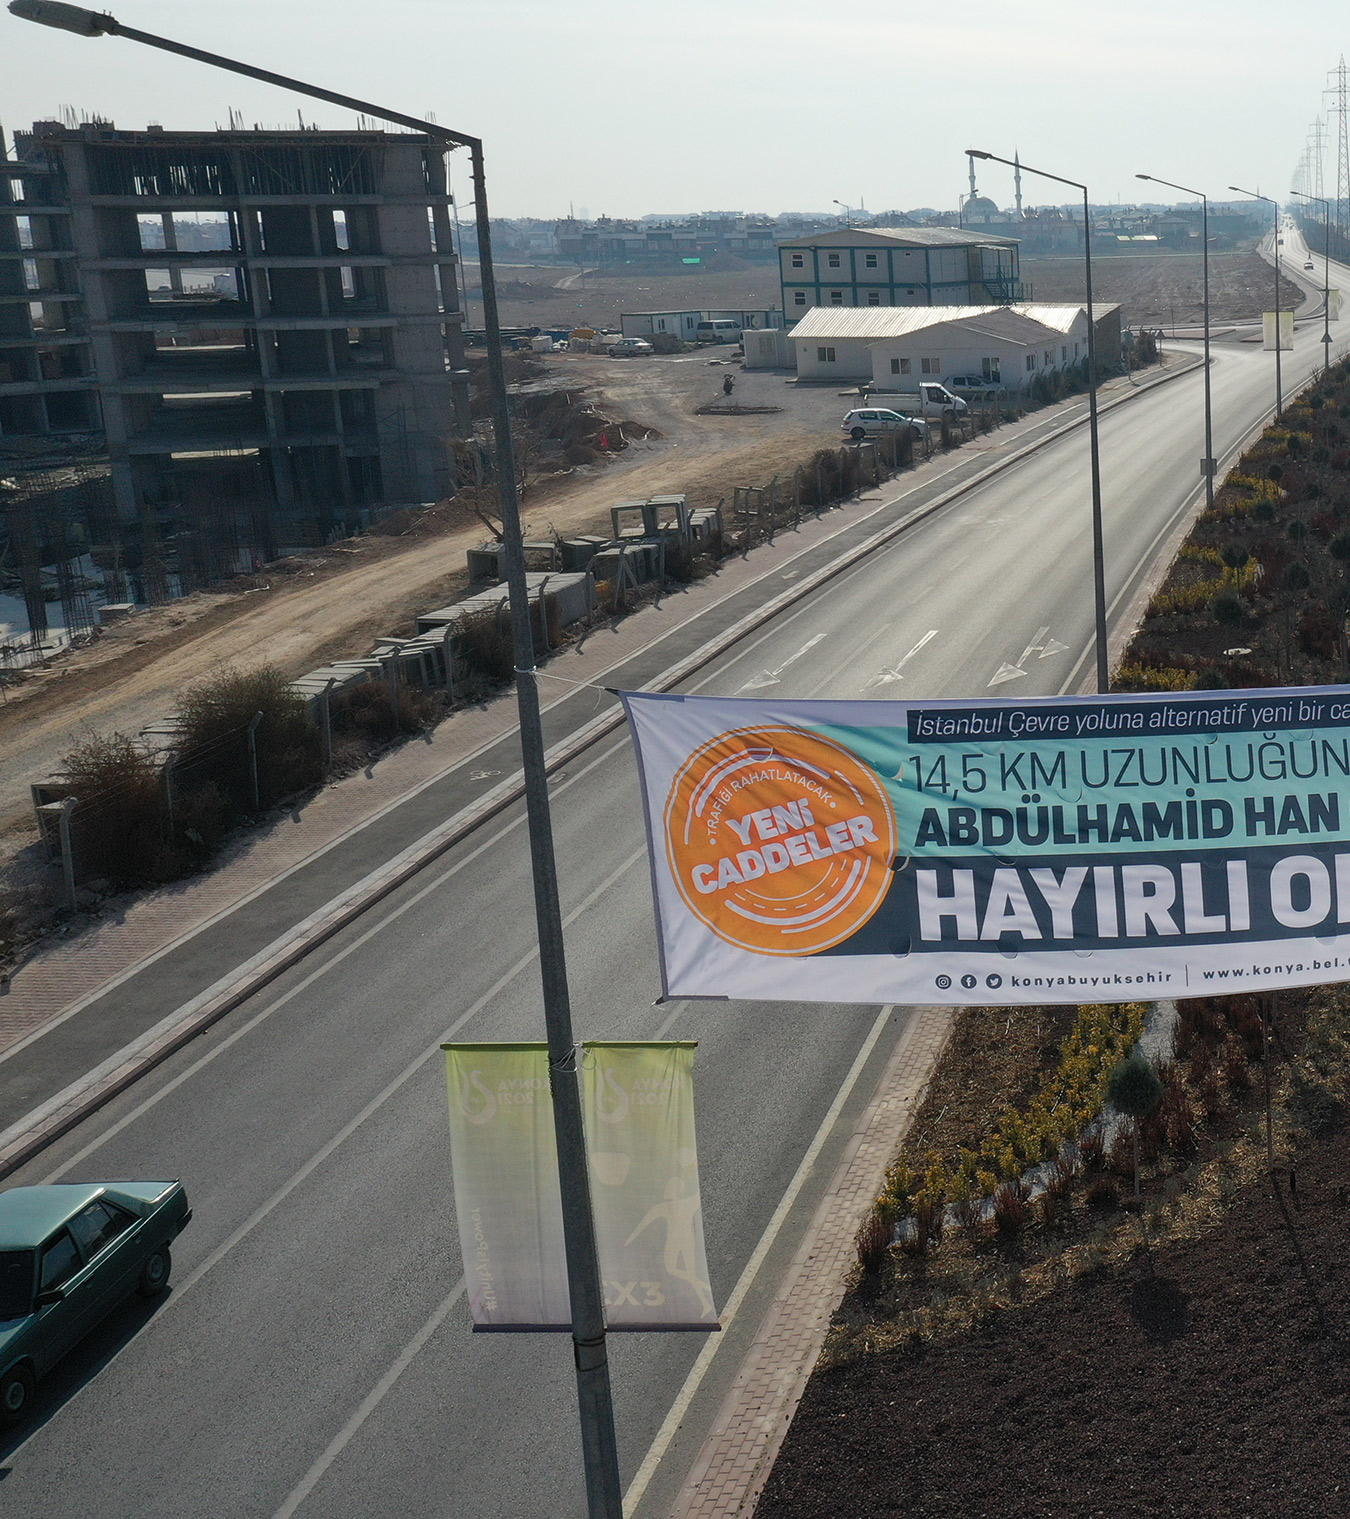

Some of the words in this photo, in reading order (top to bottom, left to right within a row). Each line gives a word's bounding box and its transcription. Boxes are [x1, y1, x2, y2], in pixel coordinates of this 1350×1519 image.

[916, 709, 1003, 736] İstanbul
[1008, 711, 1070, 738] Çevre
[1075, 708, 1144, 735] yoluna
[1149, 702, 1247, 728] alternatif
[1251, 701, 1293, 729] yeni
[1299, 700, 1325, 722] bir
[707, 785, 733, 837] TRAFİĞİ
[730, 768, 833, 805] RAHATLATACAK
[909, 753, 987, 801] 14,5
[1000, 750, 1067, 791] KM
[724, 797, 816, 846] YENİ
[914, 787, 1234, 847] ABDÜLHAMİD
[1245, 792, 1340, 838] HAN
[691, 814, 880, 895] CADDELER
[915, 859, 1251, 942] HAYIRLI
[1011, 971, 1172, 988] konyabuyuksehir
